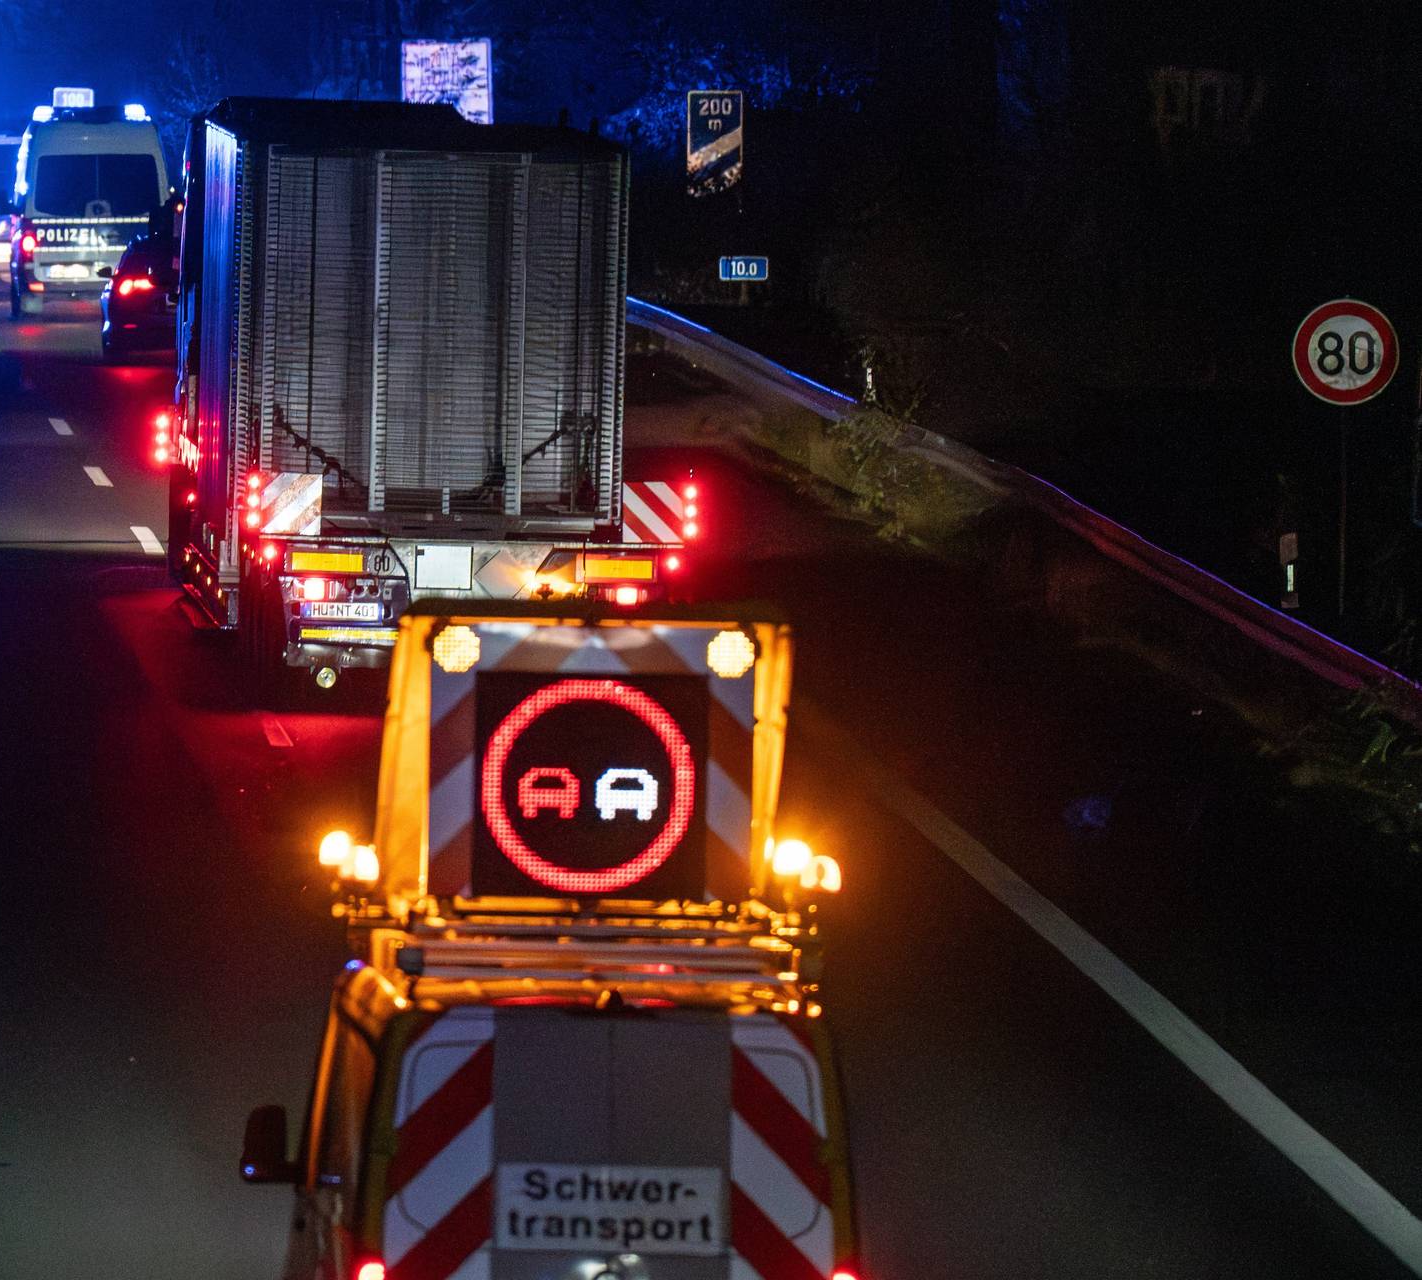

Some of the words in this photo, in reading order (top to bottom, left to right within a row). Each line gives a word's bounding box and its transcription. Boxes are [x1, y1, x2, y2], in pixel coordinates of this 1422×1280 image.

[698, 98, 733, 117] 200
[708, 117, 723, 131] m
[36, 227, 98, 246] POLIZEI
[730, 260, 758, 276] 10.0
[1317, 331, 1375, 376] 80
[373, 555, 391, 572] 80
[312, 602, 329, 616] HU
[336, 604, 352, 617] NT
[524, 1168, 698, 1203] Schwer-
[508, 1208, 712, 1248] transport
